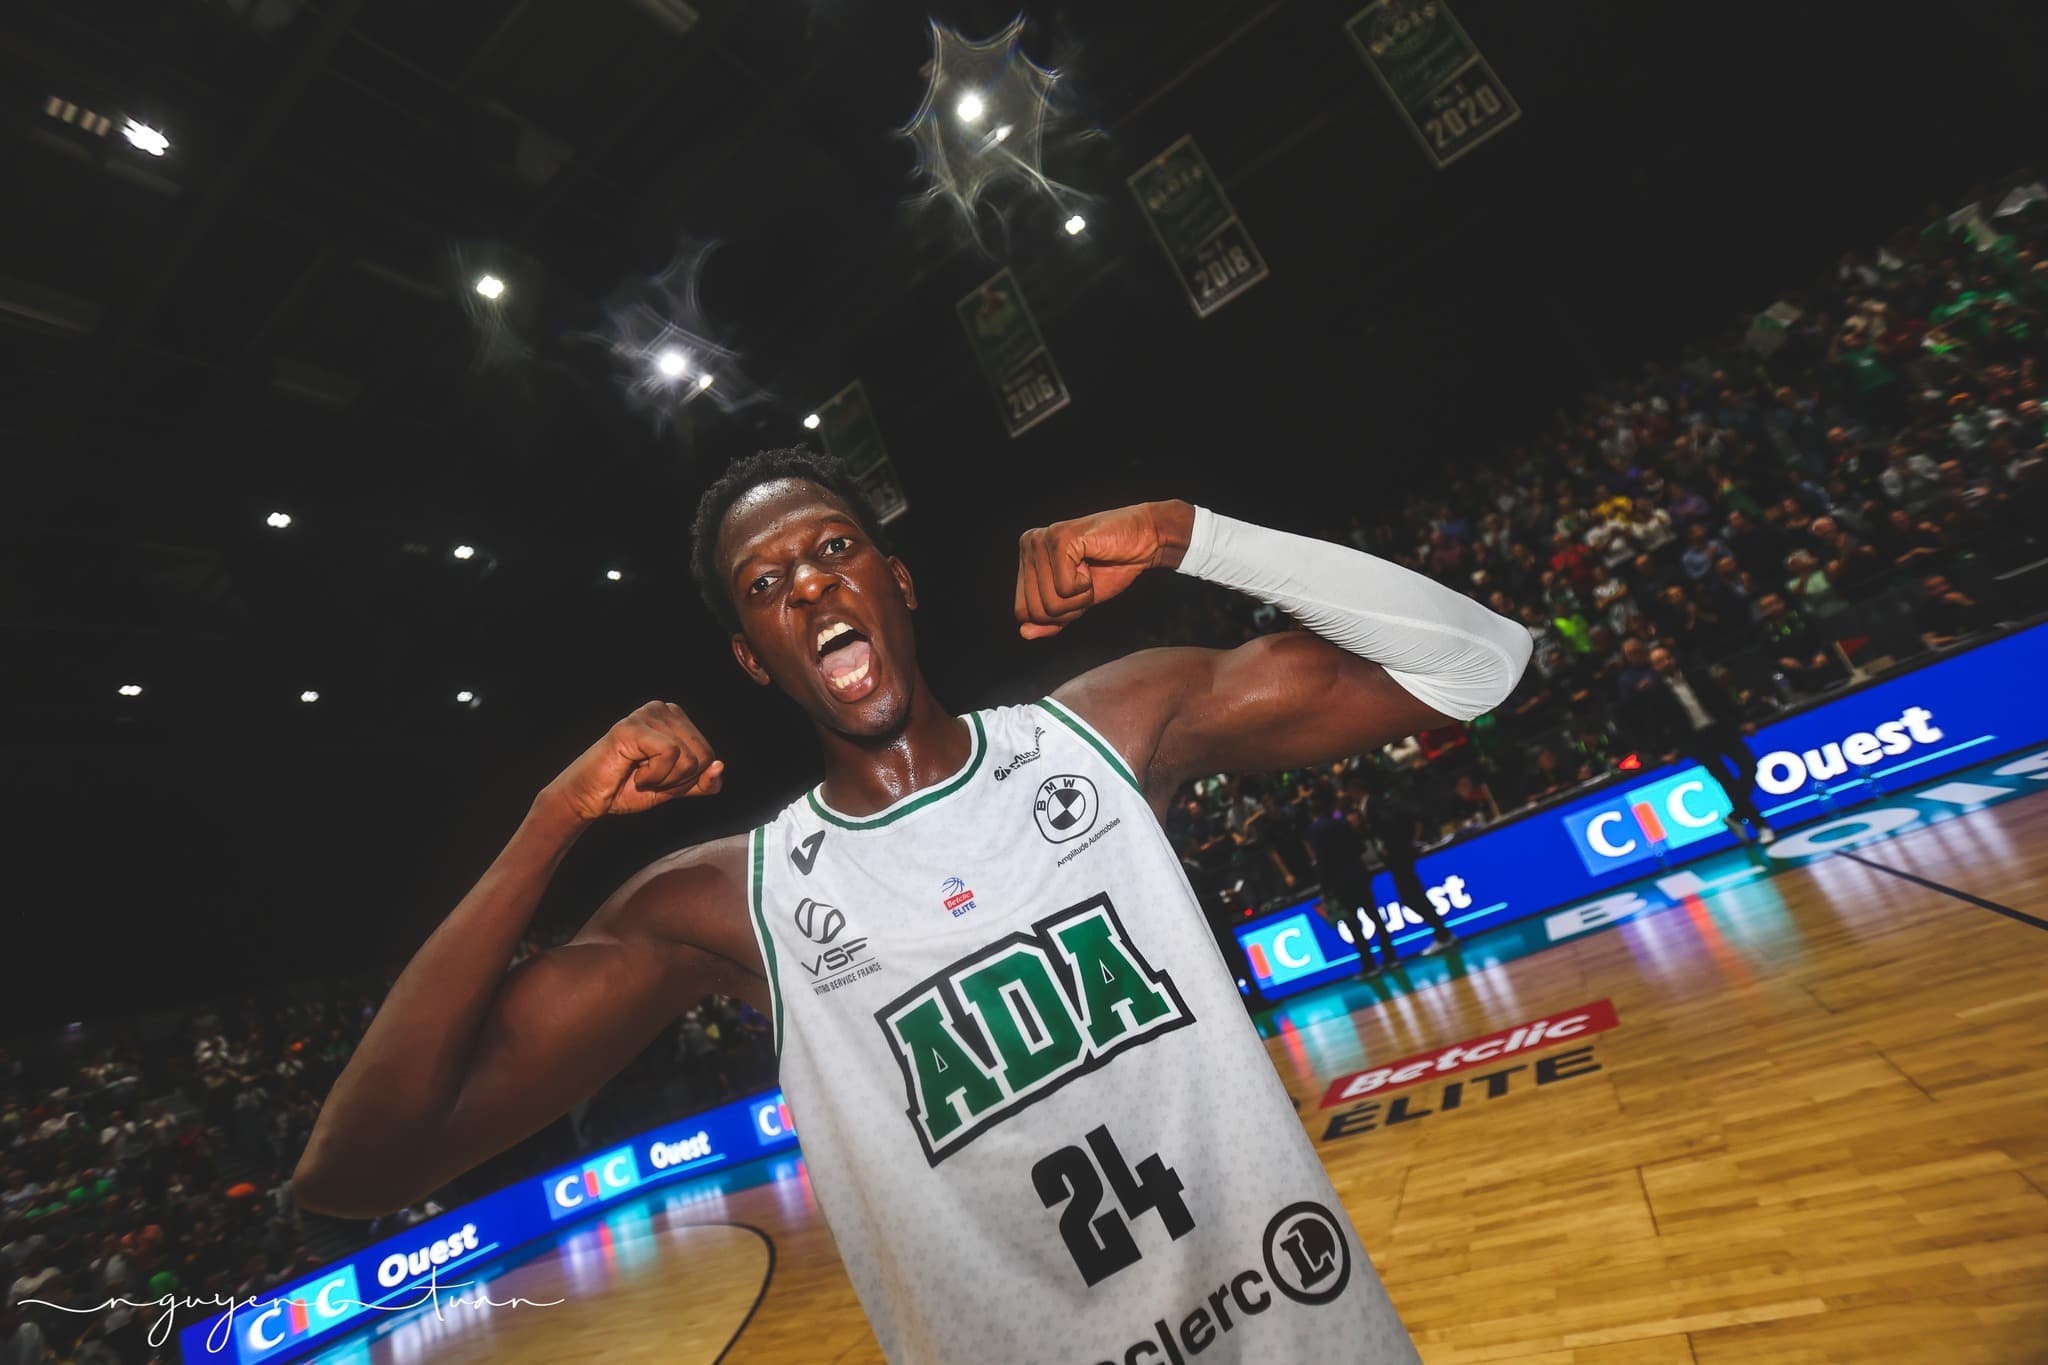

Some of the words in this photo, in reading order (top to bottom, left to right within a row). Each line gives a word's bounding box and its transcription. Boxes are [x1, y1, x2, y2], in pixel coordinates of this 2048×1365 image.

[1425, 84, 1502, 148] 2020
[1194, 245, 1251, 297] 2018
[1756, 705, 1943, 796] Ouest
[1036, 778, 1076, 811] BMW
[1586, 780, 1720, 858] CIC
[1057, 842, 1089, 867] Amplitude
[1089, 817, 1121, 846] Automobiles
[800, 937, 868, 977] VSF
[814, 981, 831, 996] VITRO
[830, 970, 857, 990] SERVICE
[856, 962, 882, 980] FRANCE
[1238, 928, 1311, 987] IC
[882, 900, 1188, 1160] ADA
[1340, 1013, 1592, 1100] Betclic
[1321, 1045, 1603, 1142] ÉLITE
[554, 1156, 631, 1208] CIC
[650, 1130, 713, 1169] Ouest
[1031, 1123, 1196, 1288] 24
[247, 1276, 350, 1351] CIC
[377, 1221, 480, 1288] Ouest
[1088, 1270, 1272, 1365] clerc
